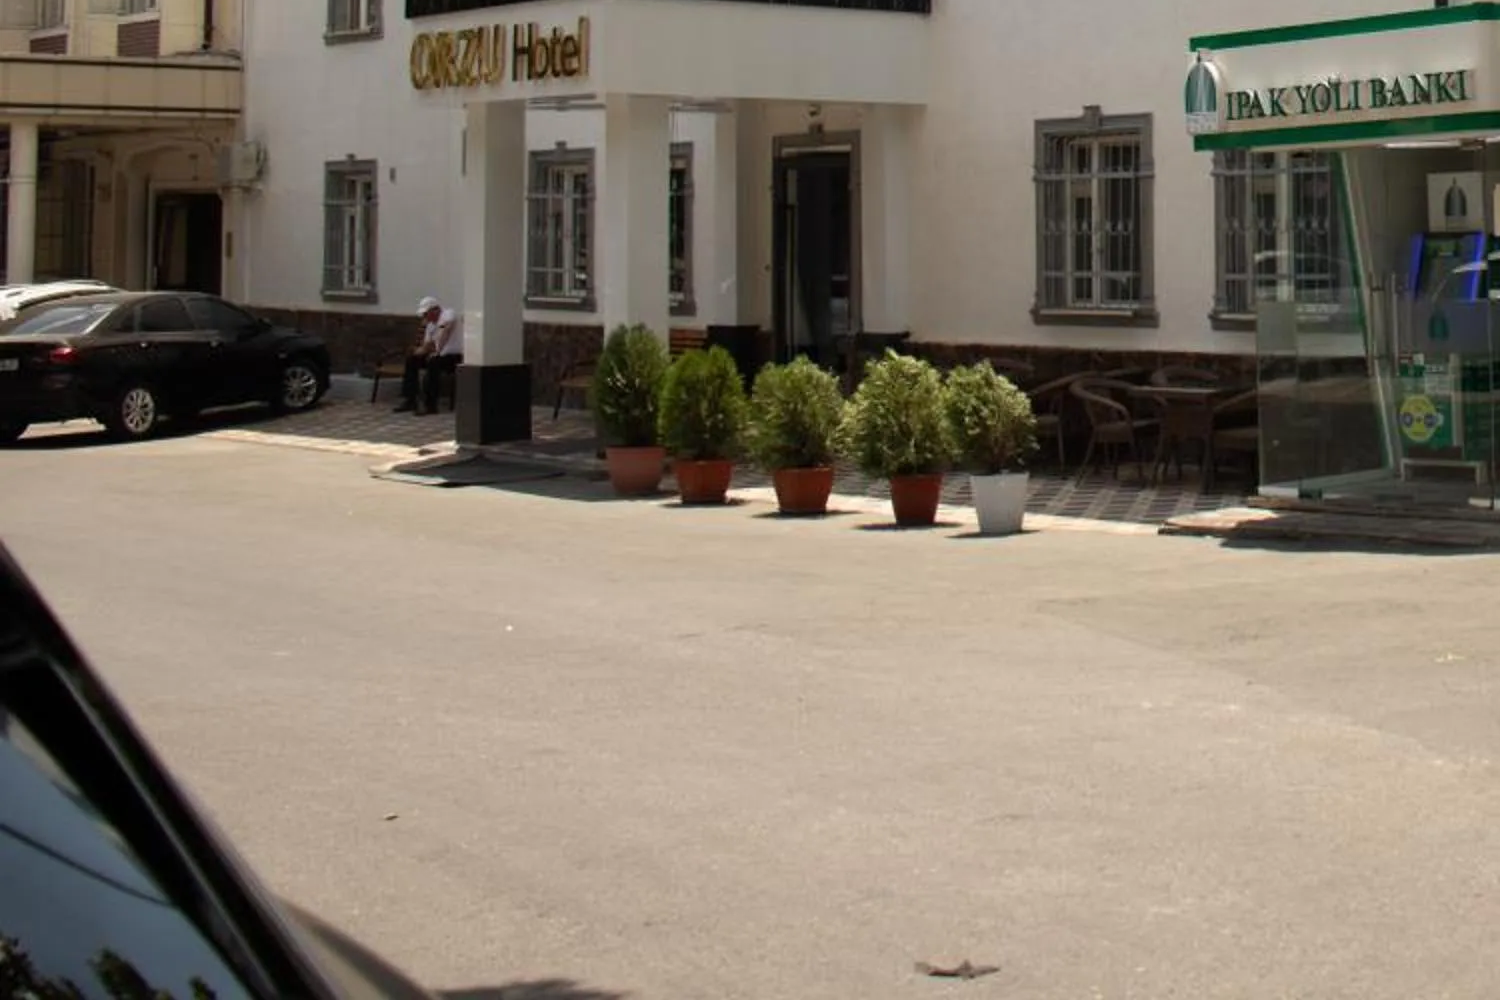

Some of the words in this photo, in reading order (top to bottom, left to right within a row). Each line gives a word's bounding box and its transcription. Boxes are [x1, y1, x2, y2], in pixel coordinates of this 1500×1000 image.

[410, 23, 506, 89] ORZU
[512, 16, 591, 82] Hotel
[1225, 86, 1288, 121] IPAK
[1369, 69, 1469, 109] BANKI
